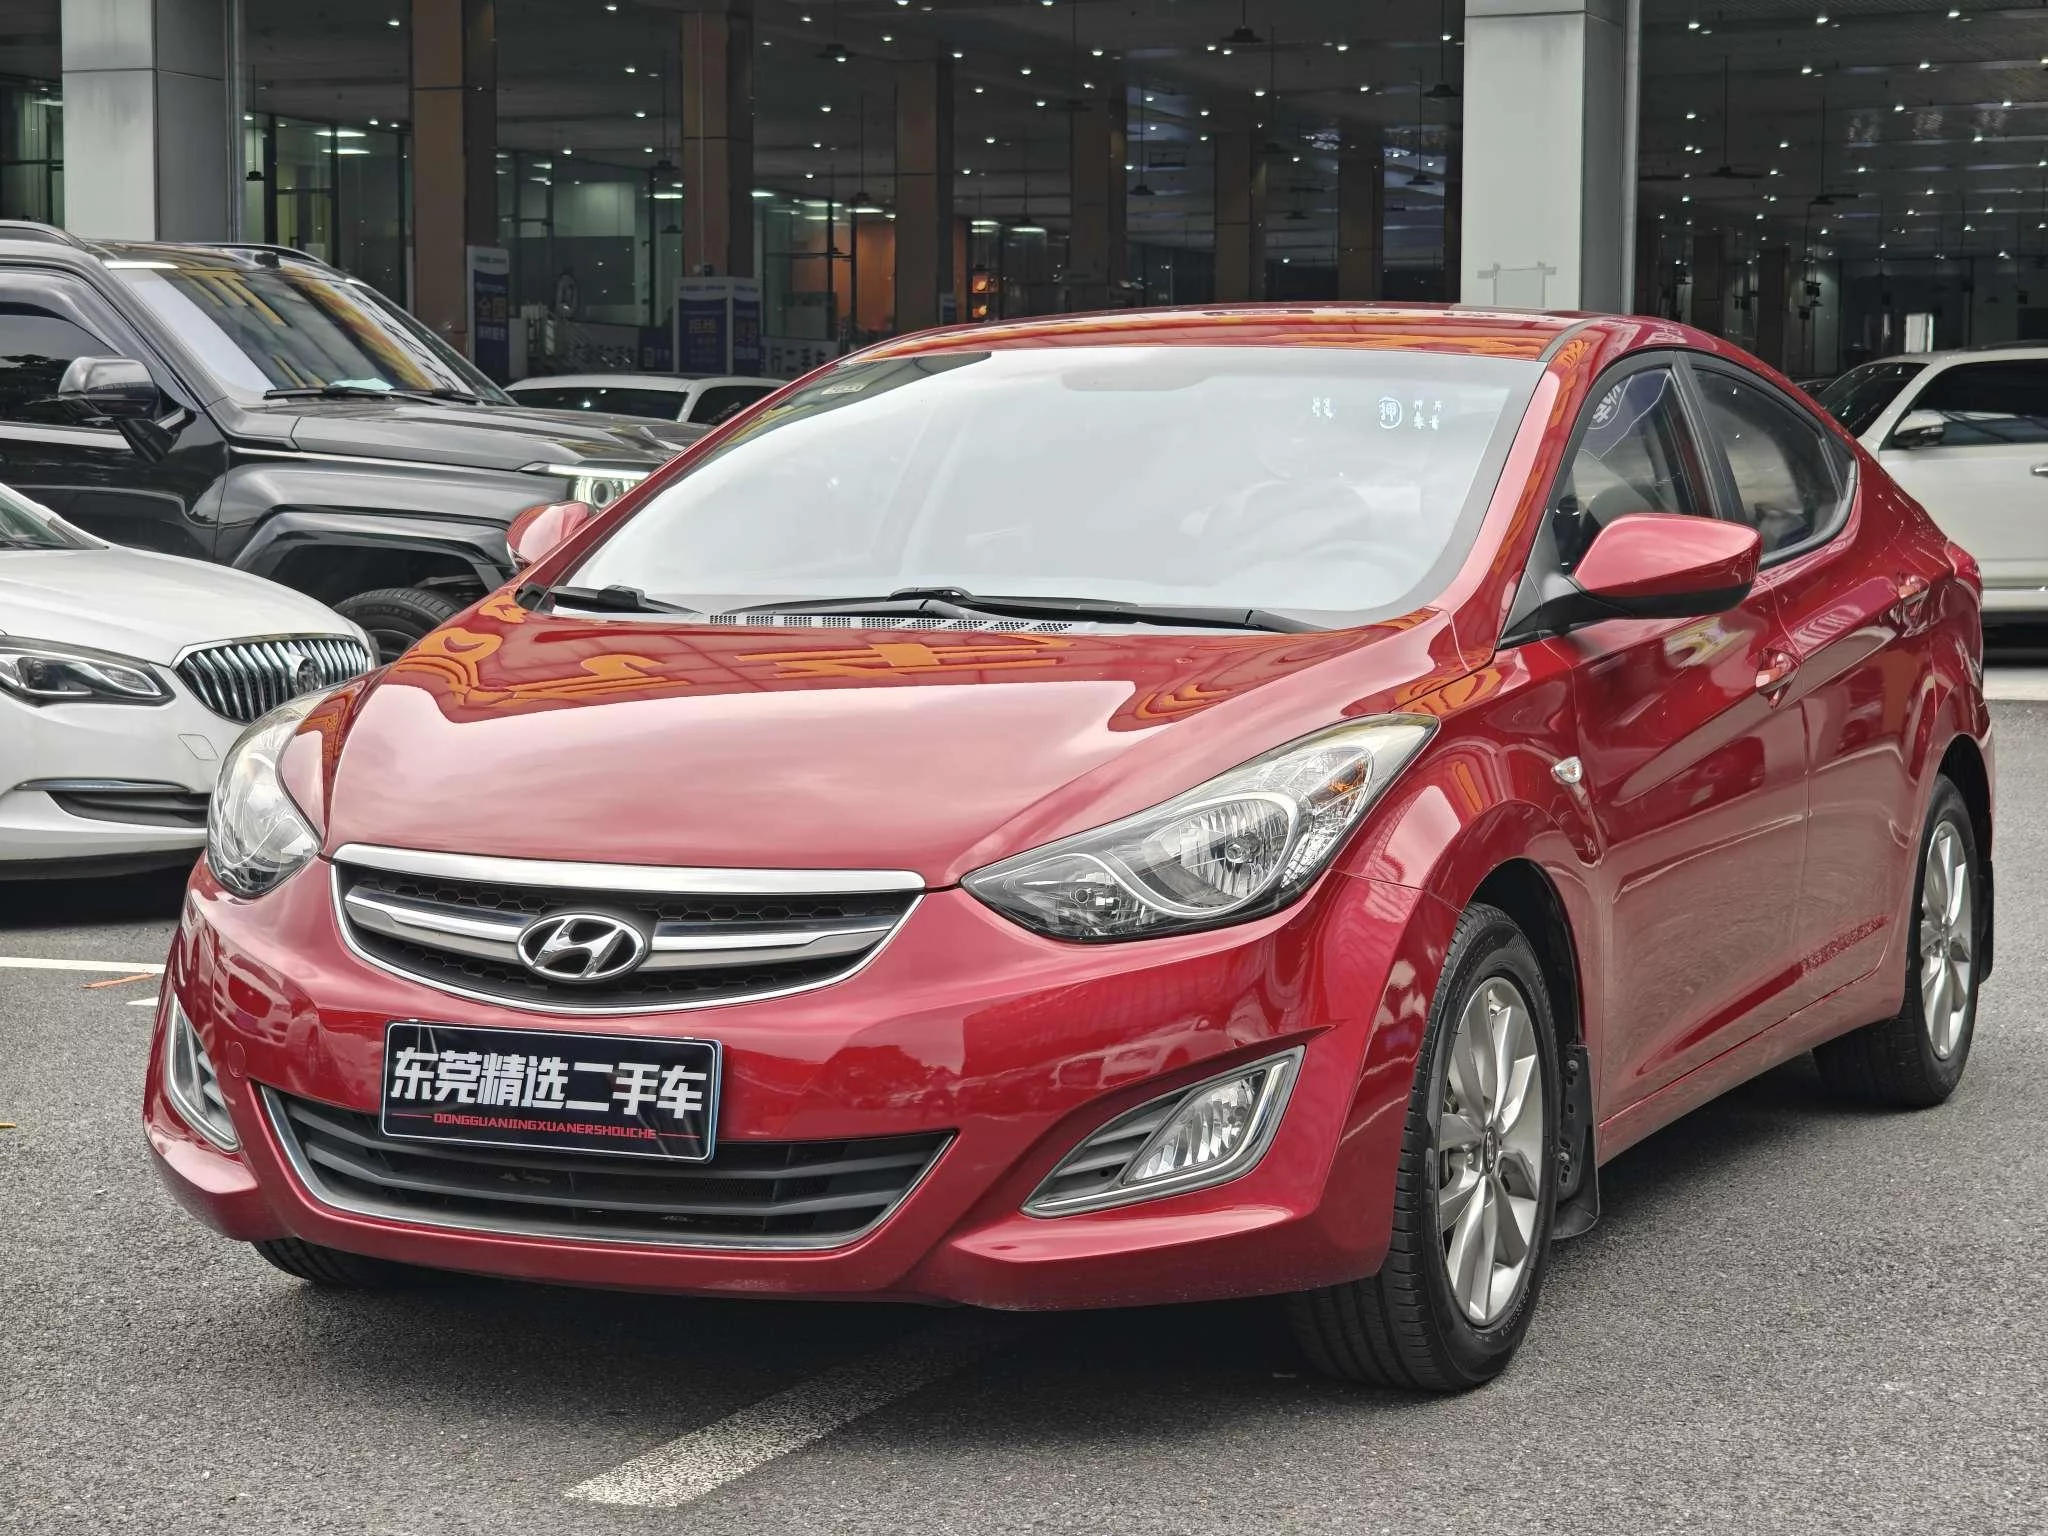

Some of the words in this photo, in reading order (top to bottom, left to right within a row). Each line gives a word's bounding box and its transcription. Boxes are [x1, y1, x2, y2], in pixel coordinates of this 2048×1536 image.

[390, 1047, 707, 1119] 东莞精选二手车
